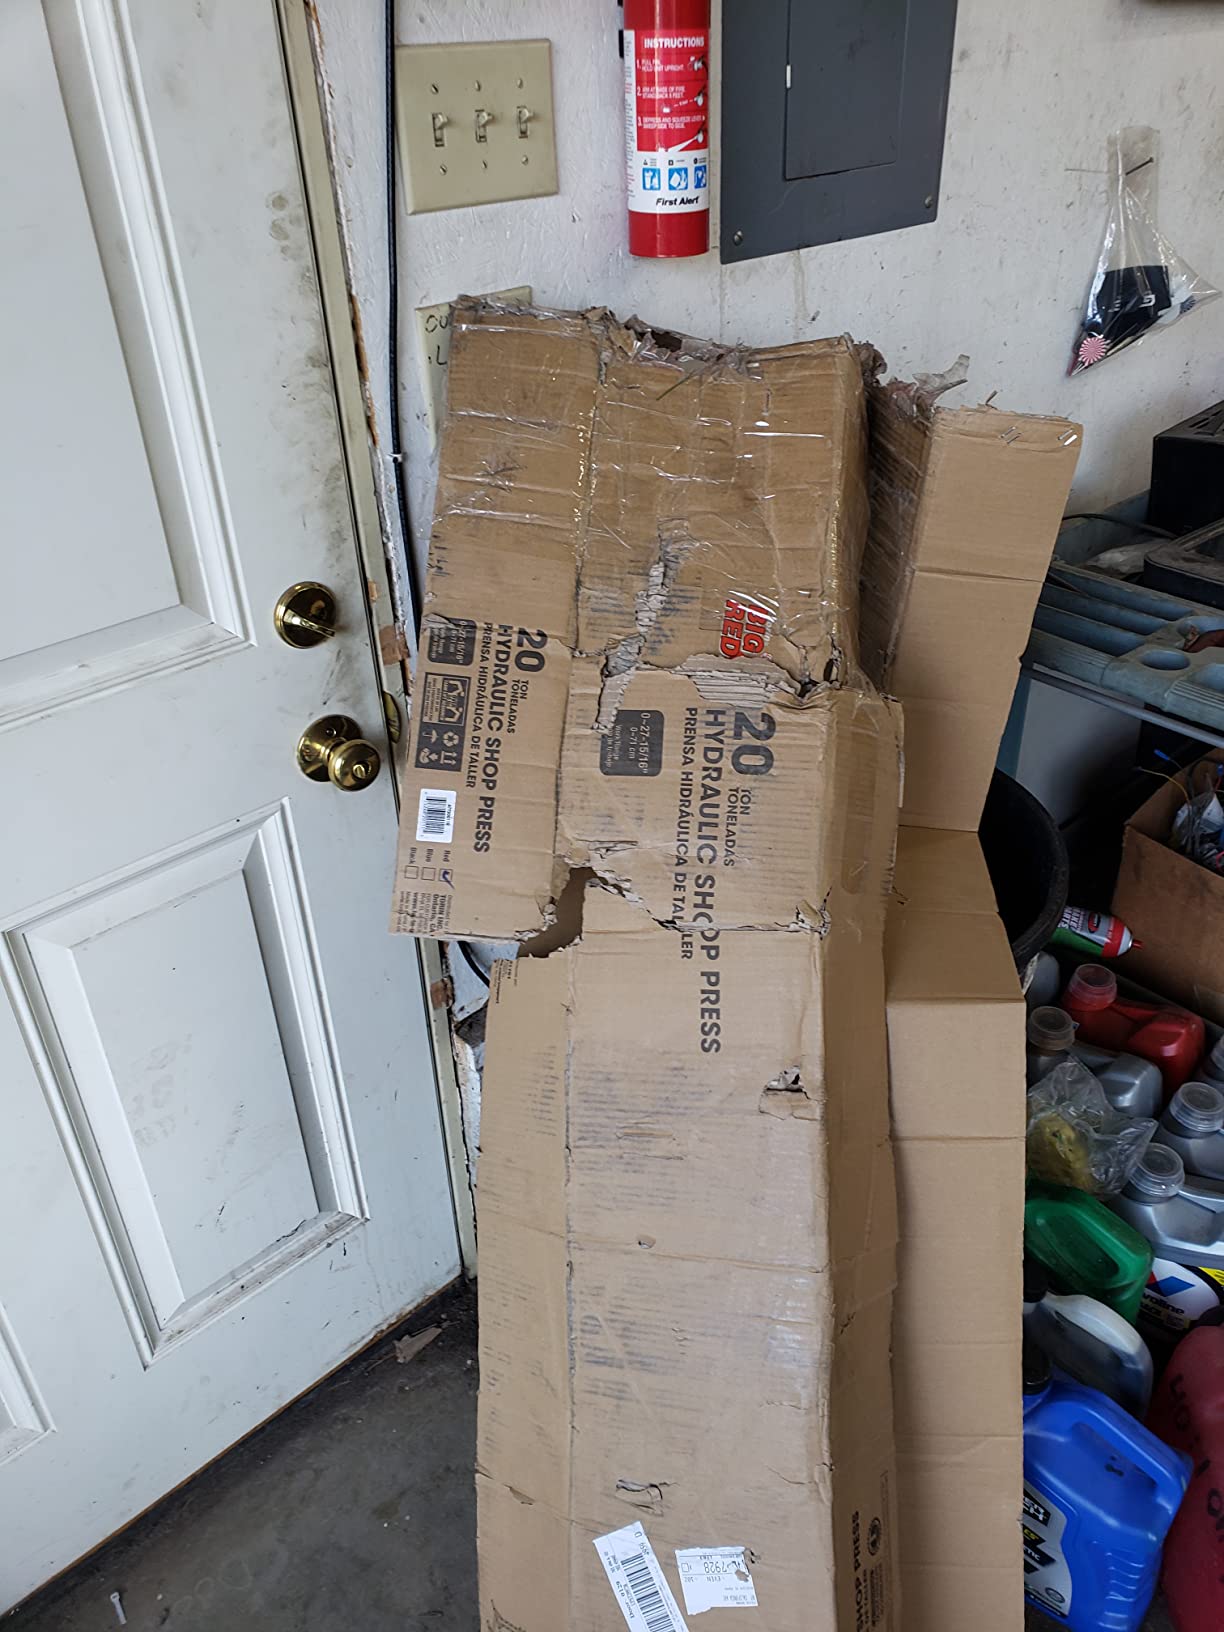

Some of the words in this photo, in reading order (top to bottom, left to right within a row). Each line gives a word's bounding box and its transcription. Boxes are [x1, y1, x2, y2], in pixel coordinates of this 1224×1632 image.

[644, 37, 704, 48] INSTRUCTIONS
[656, 197, 677, 206] First
[679, 196, 699, 206] Alert
[479, 622, 494, 663] PRENSA
[514, 627, 548, 672] 20
[720, 600, 747, 659] RED
[743, 604, 769, 654] BIG
[472, 666, 489, 732] HIDRÁULICA
[487, 624, 513, 732] HYDRAULIC
[518, 679, 529, 700] TON
[506, 679, 520, 734] TONELADAS
[470, 735, 481, 750] DE
[628, 748, 635, 759] cm
[681, 707, 698, 766] PRENSA
[731, 711, 776, 775] 20
[465, 751, 481, 789] TALLER
[481, 737, 502, 791] SHOP
[696, 709, 727, 865] HYDRAULIC
[739, 789, 752, 815] TON
[474, 796, 497, 854] PRESS
[675, 771, 694, 867] HIDRÁULICA
[723, 787, 739, 867] TONELADAS
[408, 847, 418, 864] Black
[425, 849, 434, 863] Blue
[442, 850, 451, 863] Red
[673, 872, 687, 892] DE
[431, 894, 439, 921] Ontario,
[438, 894, 447, 917] TORIN
[692, 874, 721, 961] SHOP
[700, 971, 722, 1053] PRESS
[1142, 1293, 1185, 1315] voline
[852, 1511, 861, 1572] PRESS
